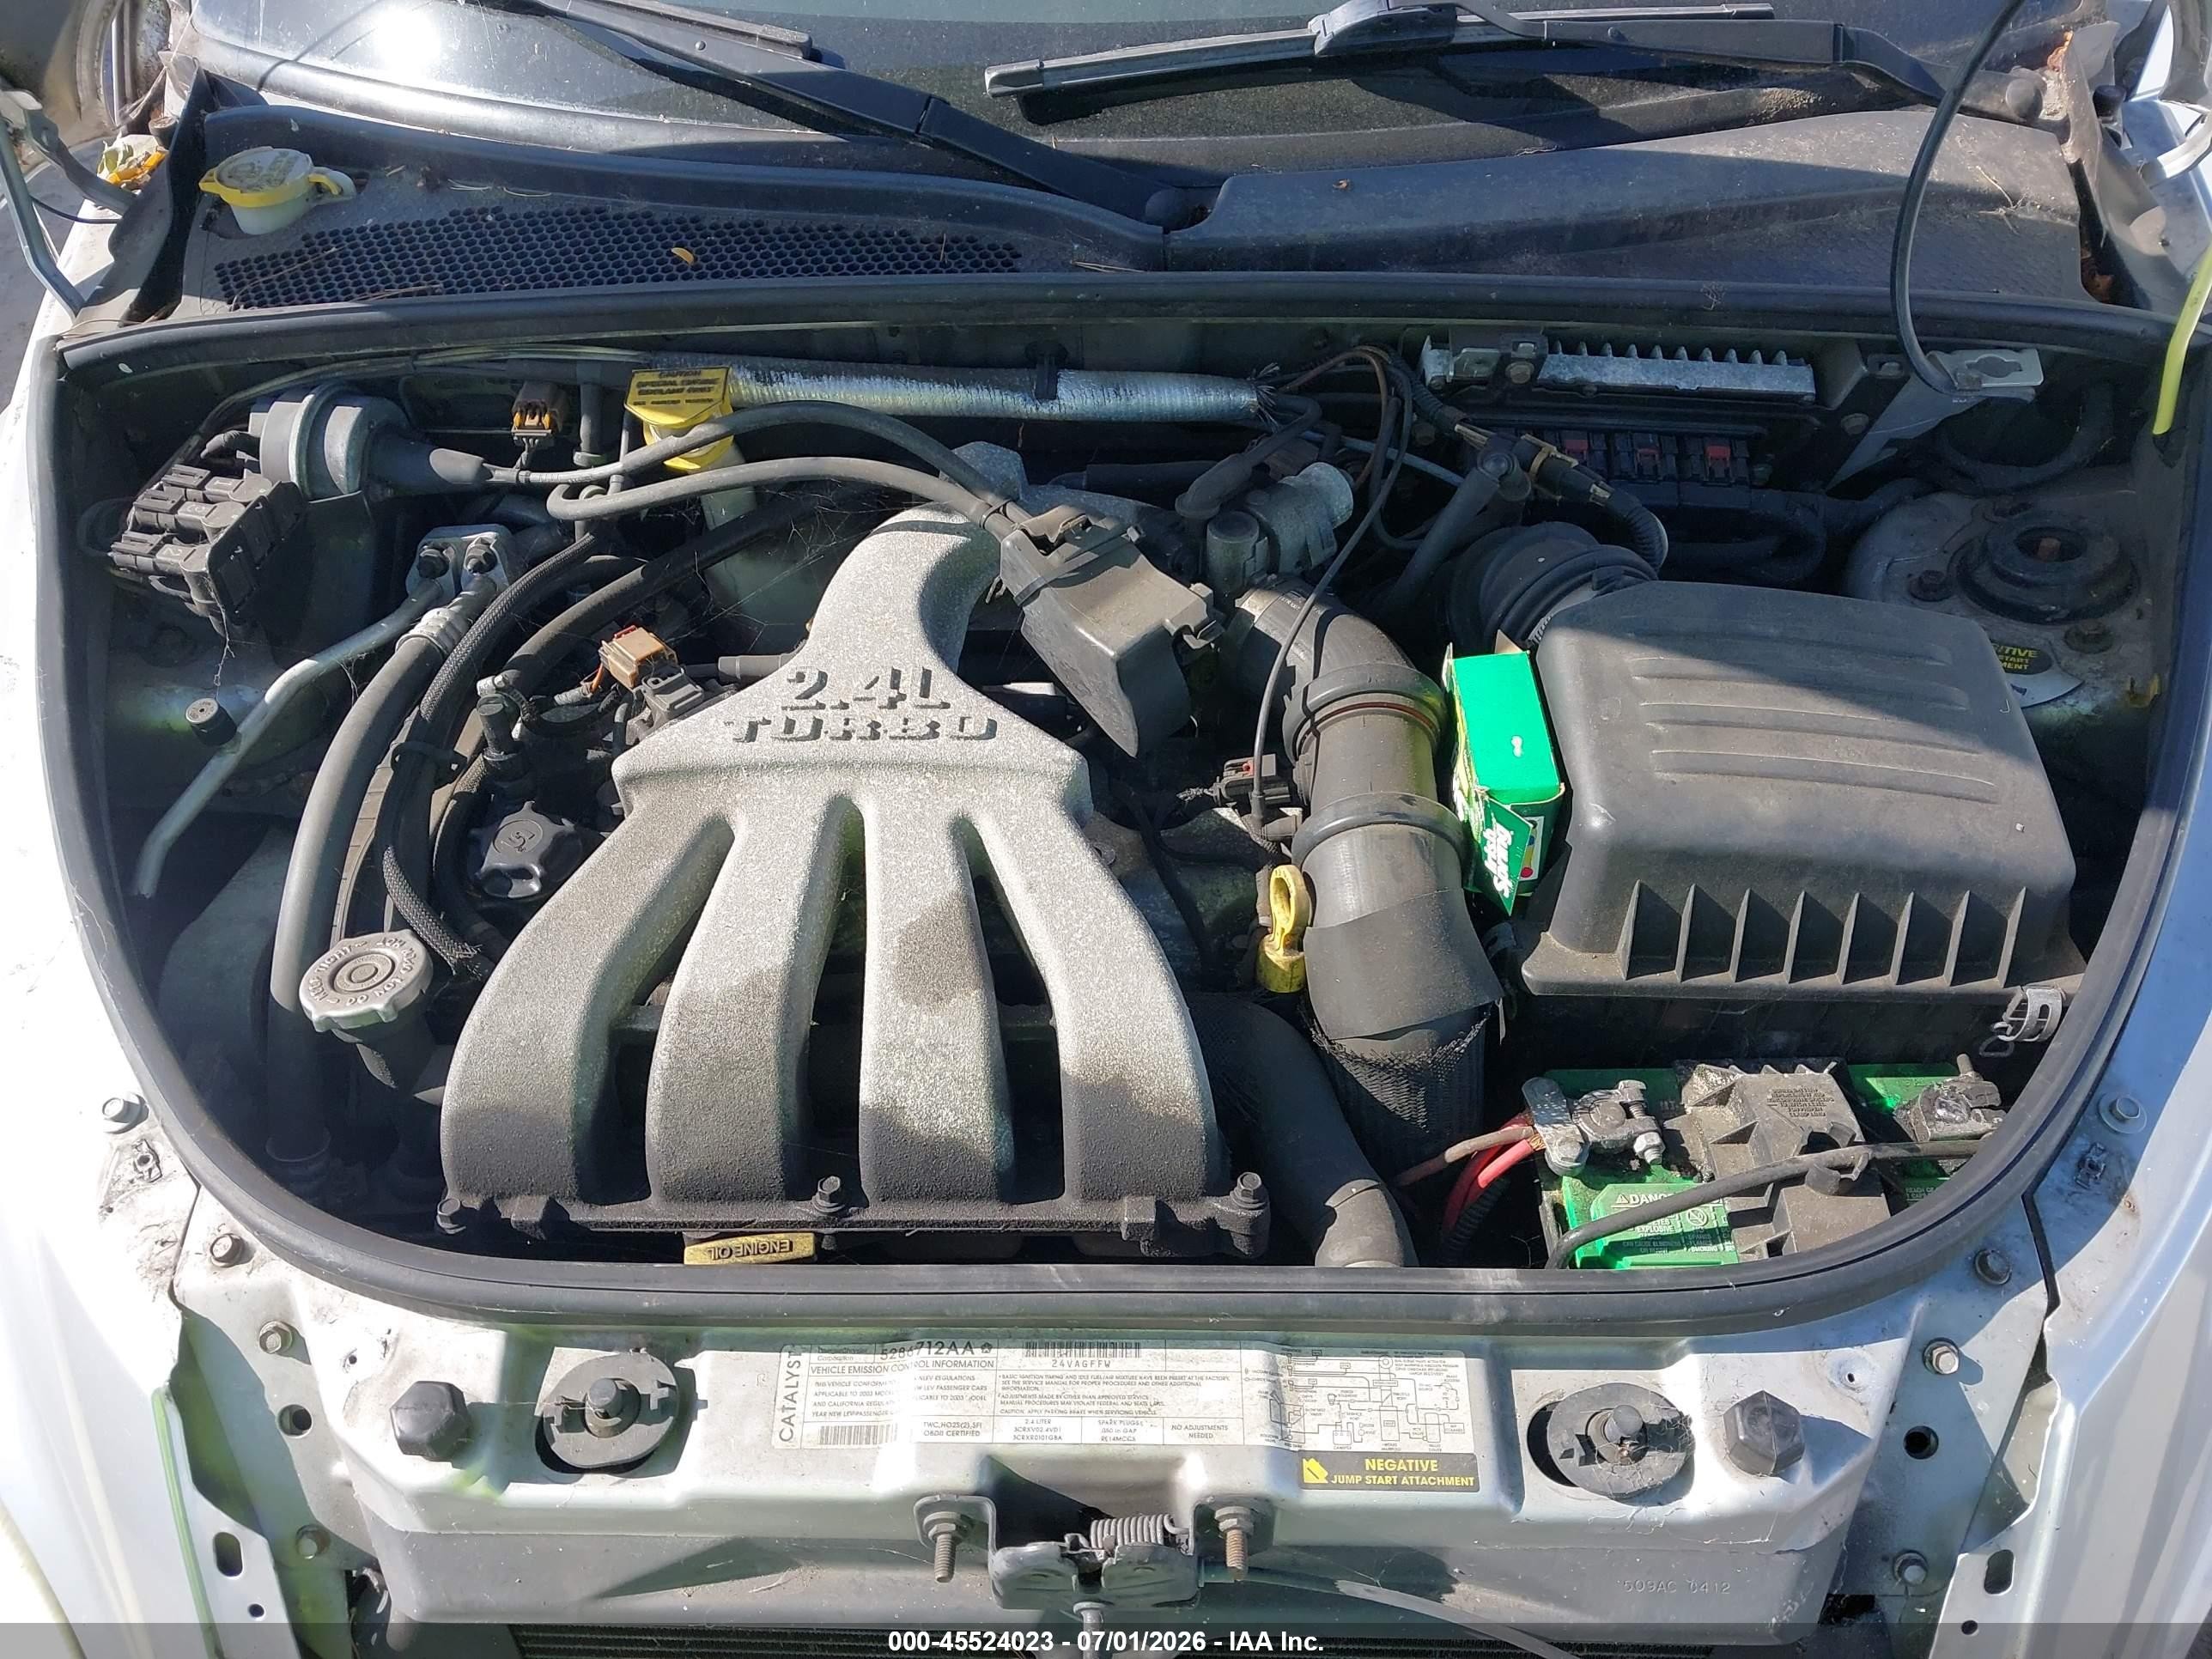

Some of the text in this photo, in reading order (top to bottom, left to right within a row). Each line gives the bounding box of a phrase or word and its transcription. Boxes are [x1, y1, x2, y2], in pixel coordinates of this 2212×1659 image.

[781, 666, 951, 711] 2.4L
[726, 715, 999, 744] TURBO
[1492, 821, 1512, 898] Spring
[707, 1238, 793, 1261] ENGINE OIL
[811, 1365, 846, 1374] VEHICLE
[848, 1364, 890, 1374] EMISSION
[779, 1351, 802, 1443] CATALYST
[1364, 1458, 1438, 1472] NEGATIVE
[1331, 1474, 1474, 1486] JUMP START ATTACHMENT
